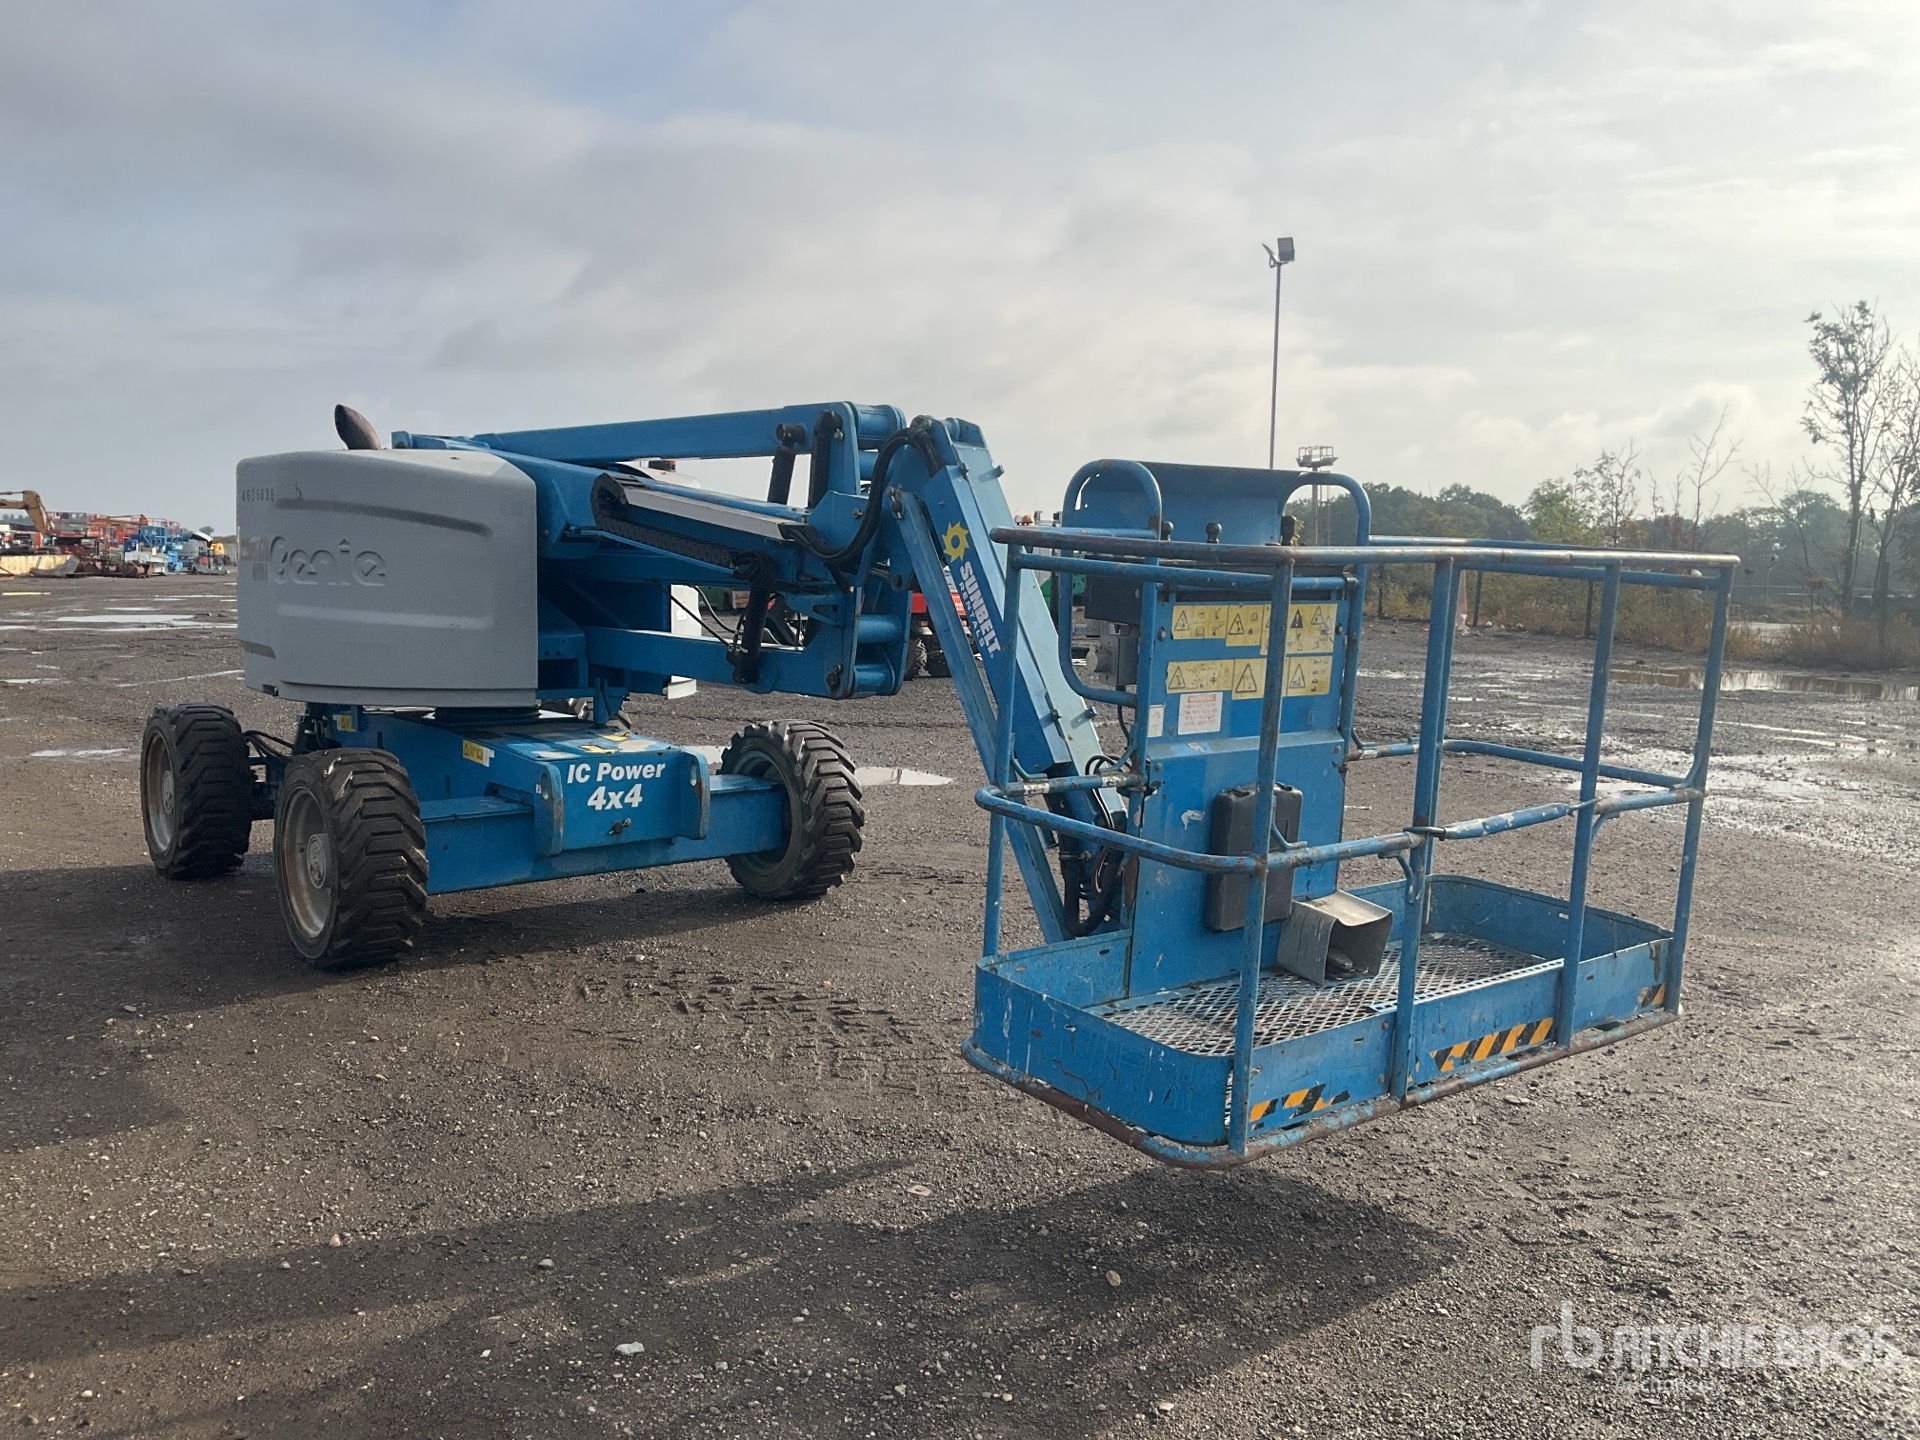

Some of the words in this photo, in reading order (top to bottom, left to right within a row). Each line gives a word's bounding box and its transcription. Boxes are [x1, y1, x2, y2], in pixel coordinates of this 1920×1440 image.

[269, 535, 386, 587] Genie
[959, 560, 1001, 655] SUNBELT
[959, 581, 985, 647] RENTALS
[566, 763, 591, 784] IC
[596, 761, 666, 783] Power
[587, 783, 643, 811] 4x4
